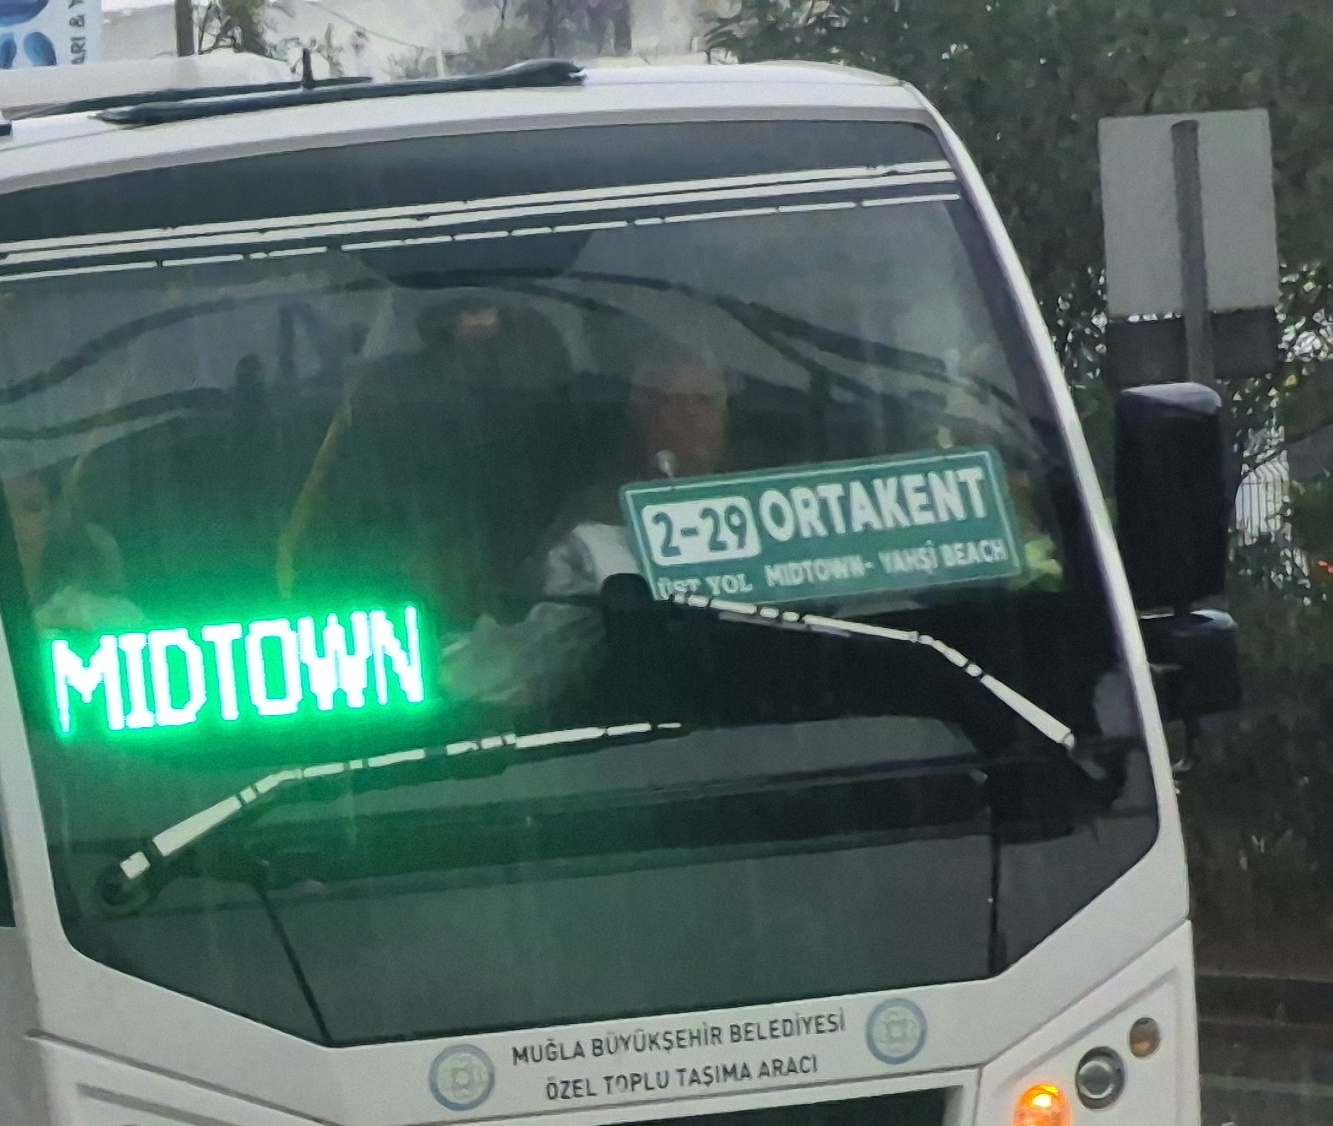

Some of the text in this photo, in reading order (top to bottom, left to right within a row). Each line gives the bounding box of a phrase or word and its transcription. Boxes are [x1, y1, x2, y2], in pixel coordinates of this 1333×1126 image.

[652, 467, 988, 558] 2-29 ORTAKENT
[704, 573, 753, 596] YOL
[939, 538, 1009, 567] BEACH
[51, 606, 425, 733] MIDTOWN
[511, 1007, 847, 1066] MUĞLA BÜYÜKŞEHİR BELEDİYESİ
[546, 1054, 819, 1100] ÖZEL TOPLU TAŞIMA ARACI
